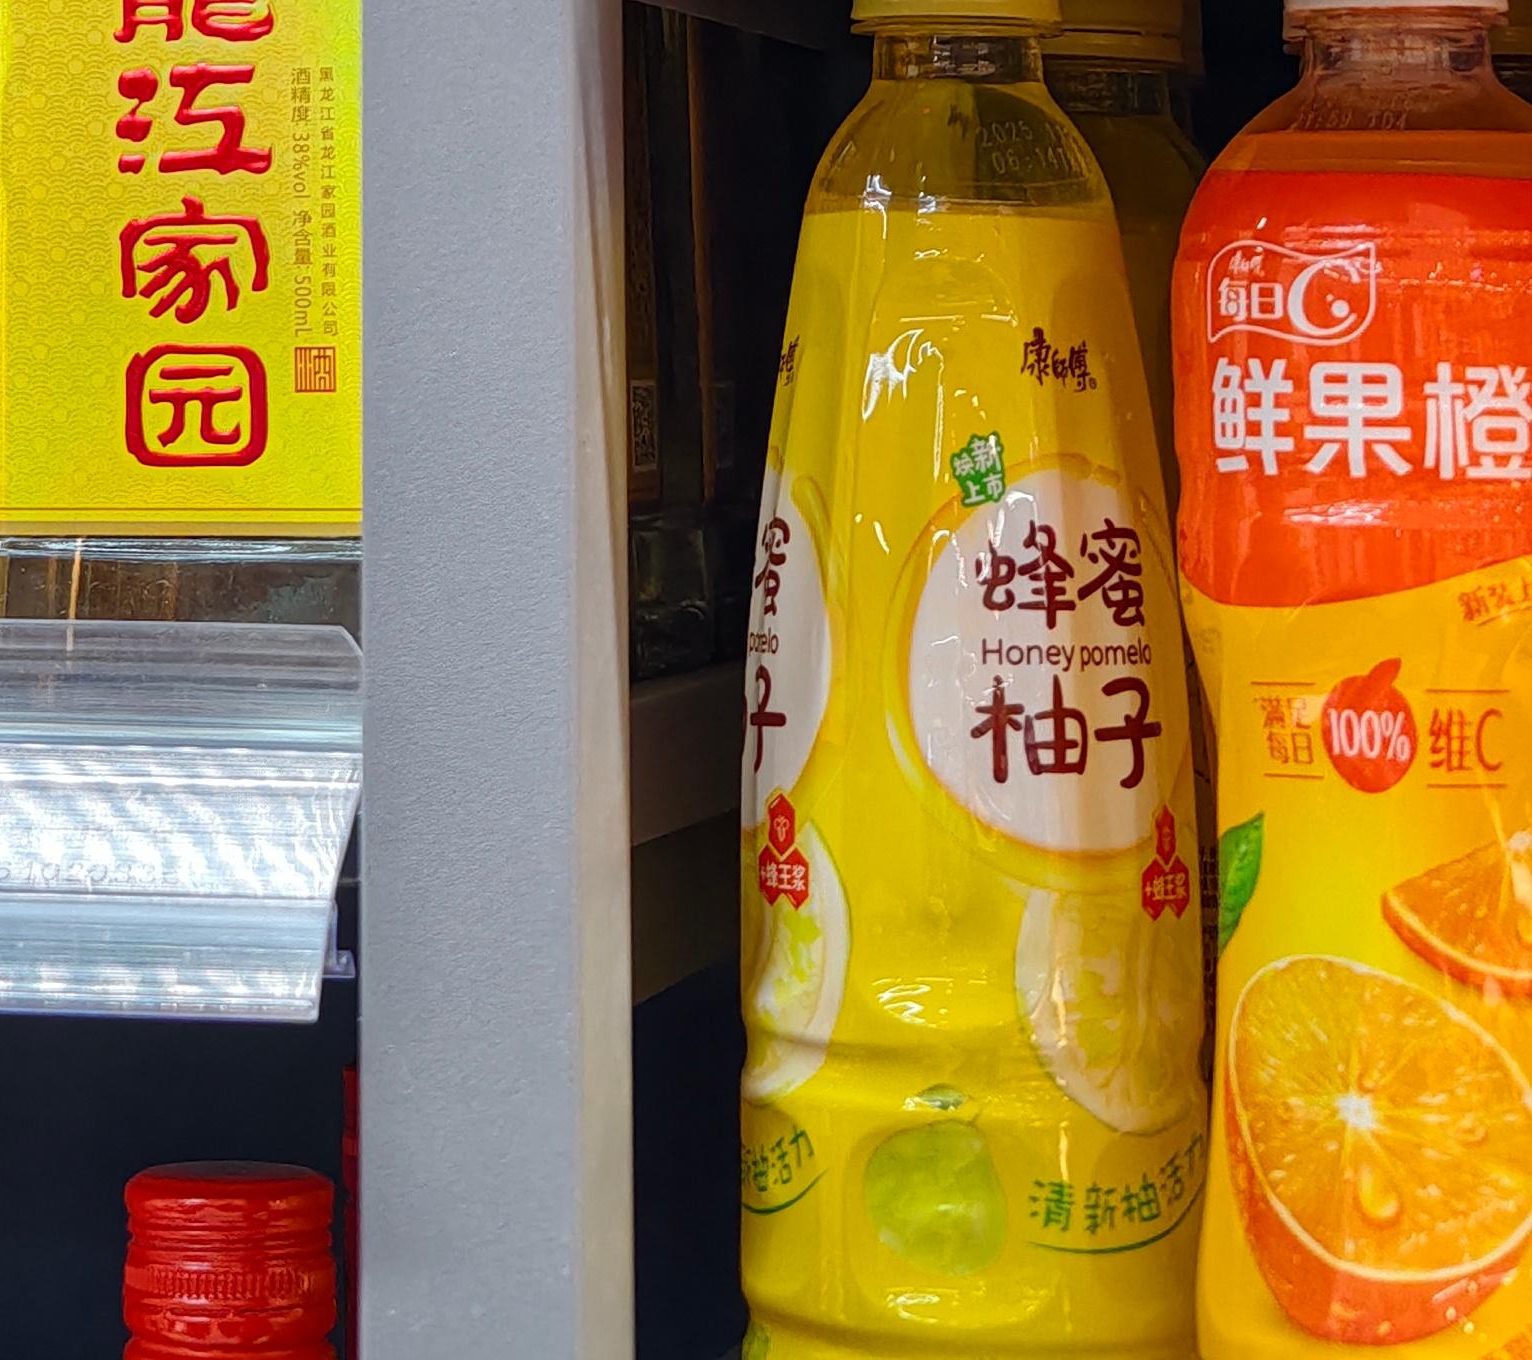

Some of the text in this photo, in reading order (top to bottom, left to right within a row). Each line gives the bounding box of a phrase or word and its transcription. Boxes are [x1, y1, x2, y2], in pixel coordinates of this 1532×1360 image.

[1211, 356, 1532, 480] 鲜果橙
[975, 516, 1146, 630] 蜂蜜
[981, 638, 1153, 674] Honey pomelo
[970, 673, 1164, 789] 柚子
[1327, 706, 1412, 763] 100%
[1427, 706, 1504, 773] 维C
